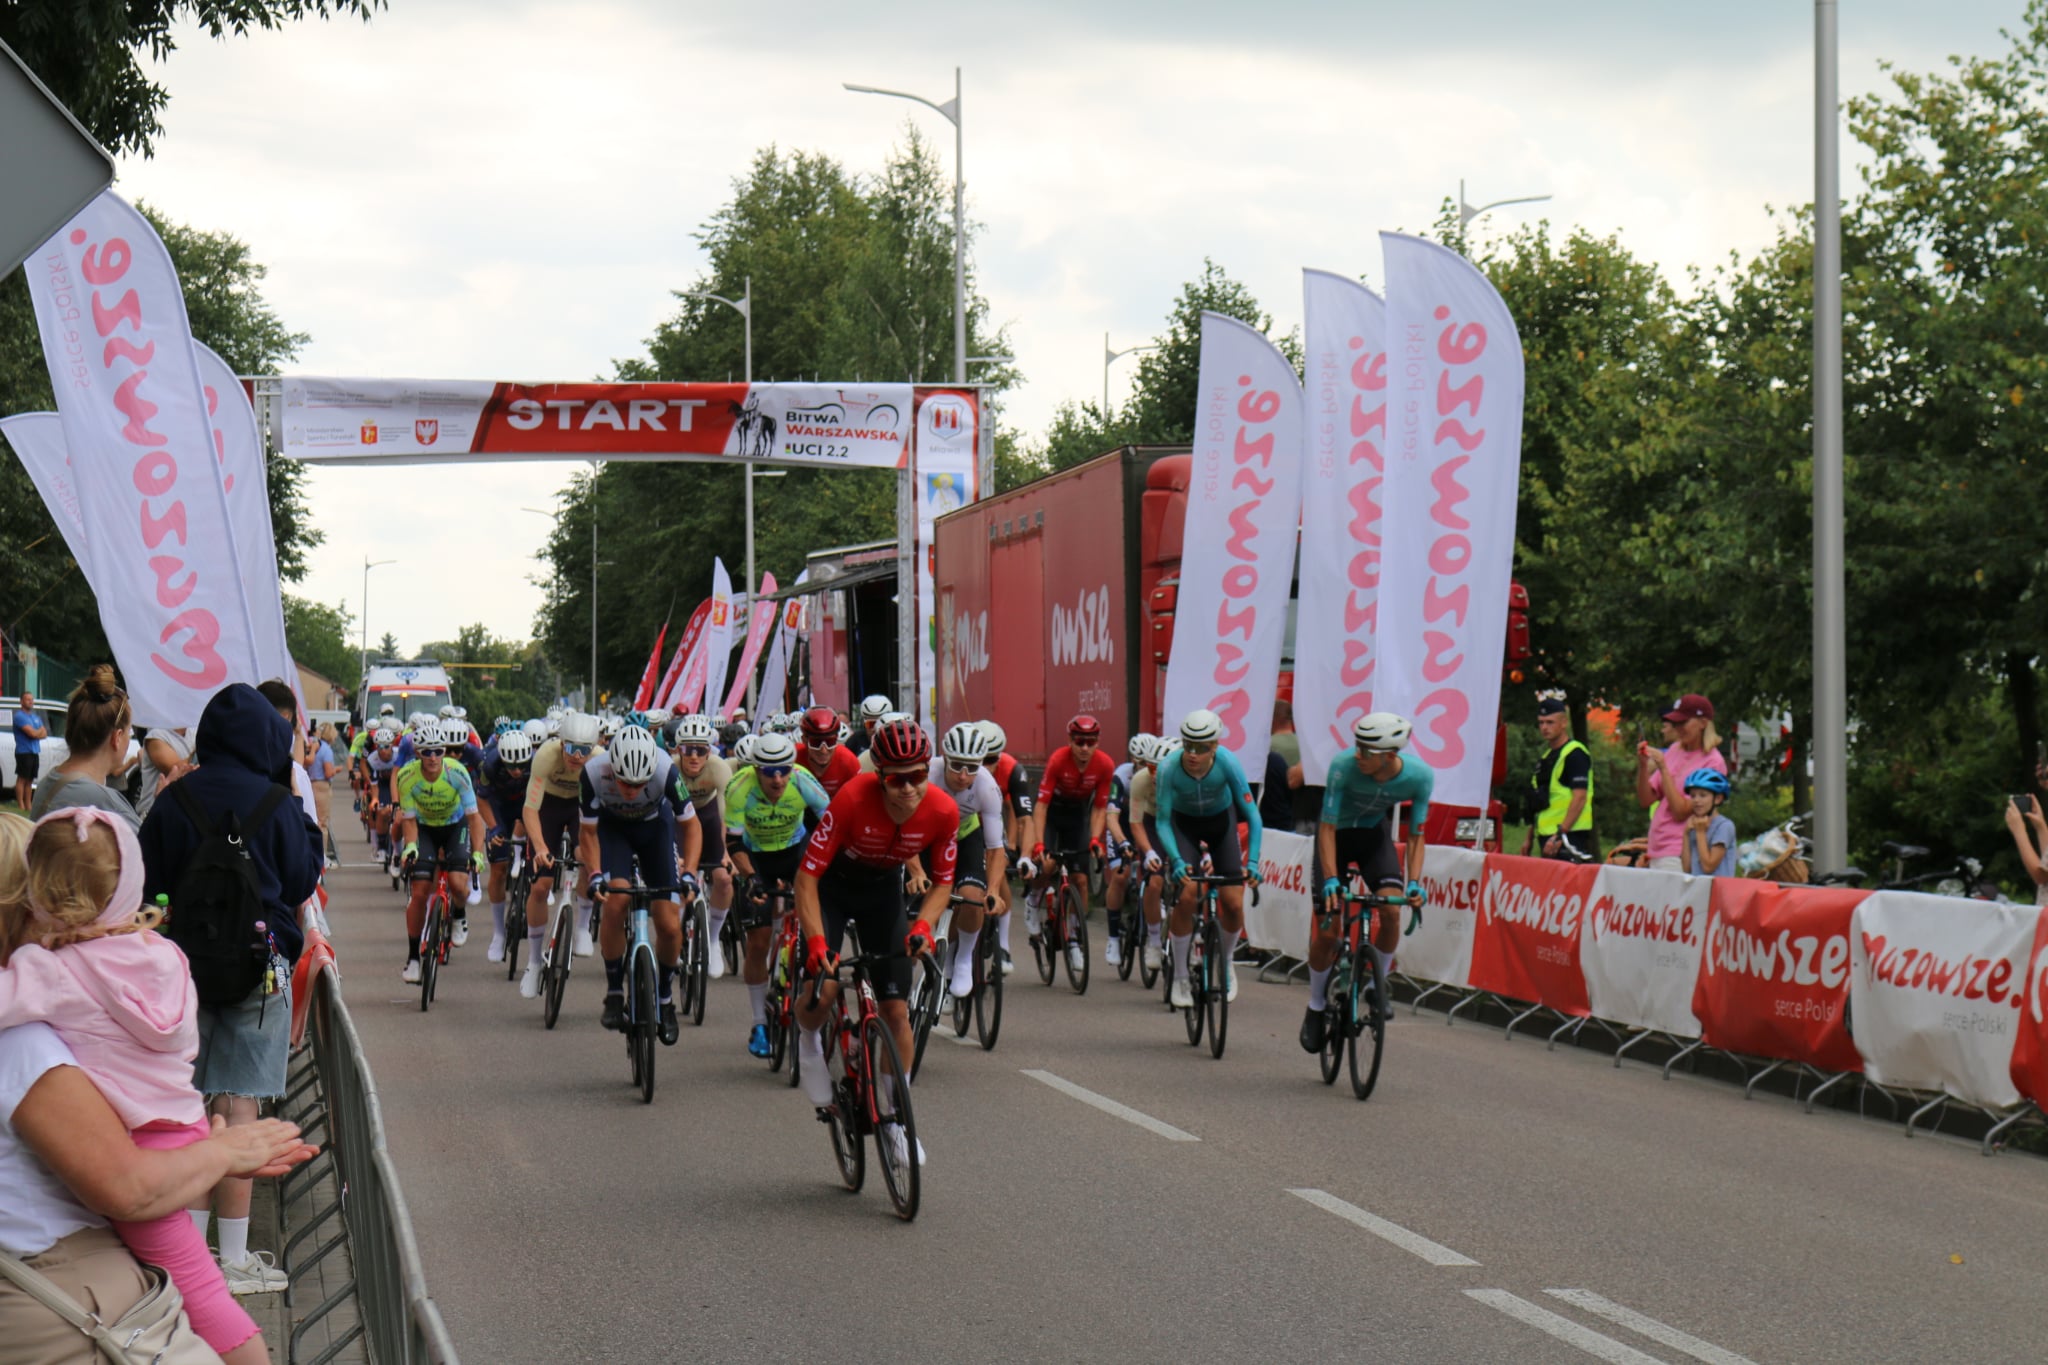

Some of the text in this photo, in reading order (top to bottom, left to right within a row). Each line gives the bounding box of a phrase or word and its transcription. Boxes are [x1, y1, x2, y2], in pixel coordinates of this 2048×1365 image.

[506, 399, 707, 433] START
[786, 411, 840, 425] BITWA
[786, 424, 900, 442] WARSZAWSKA
[792, 443, 849, 458] UCI 2.2
[1051, 584, 1114, 668] owsze.
[1484, 869, 1581, 942] Mazowsze.
[1591, 893, 1698, 948] Mazowsze.
[1775, 998, 1802, 1019] serce
[1943, 1011, 2008, 1035] serce Polski
